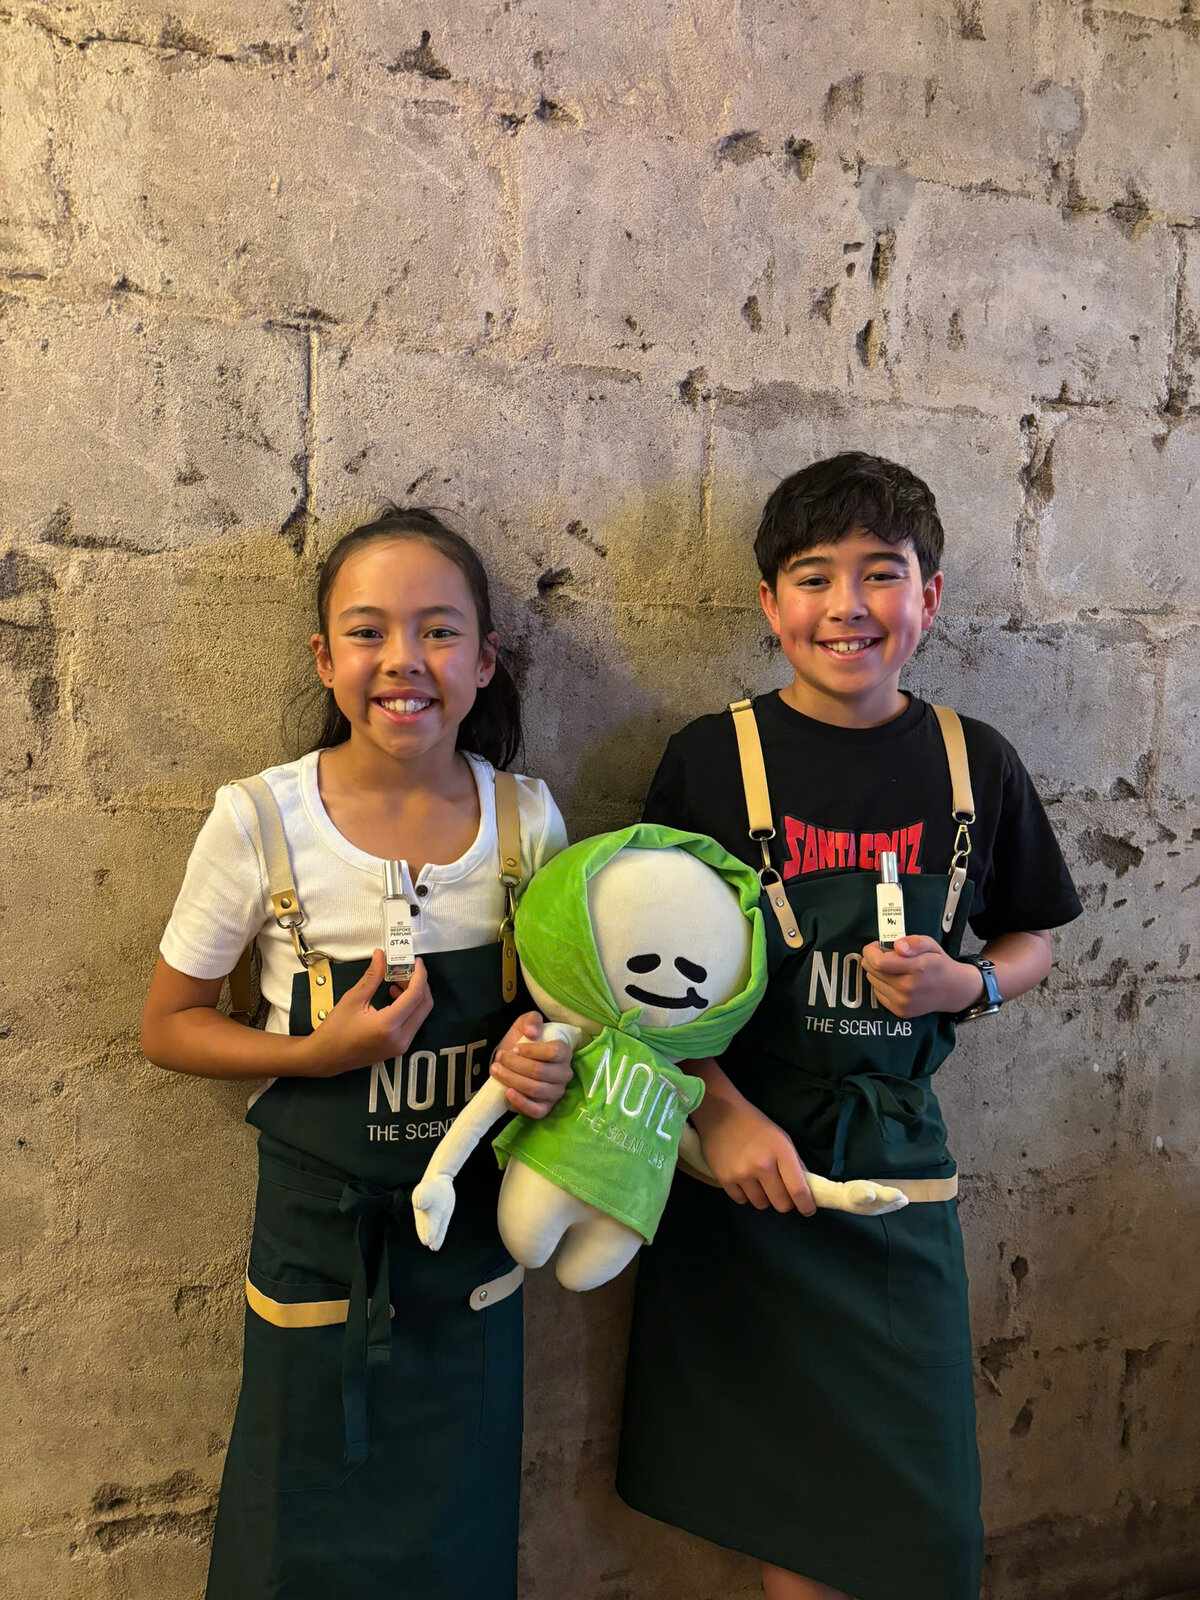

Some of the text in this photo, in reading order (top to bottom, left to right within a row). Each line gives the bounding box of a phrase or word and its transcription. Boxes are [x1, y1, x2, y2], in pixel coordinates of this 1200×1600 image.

[783, 815, 924, 881] SANTA CRUZ
[807, 950, 878, 1009] NO
[804, 1015, 912, 1037] THE SCENT LAB
[368, 1039, 488, 1113] NOTE
[588, 1047, 690, 1141] NOTE
[366, 1124, 400, 1141] THE
[576, 1107, 665, 1169] THE SCENT LAB
